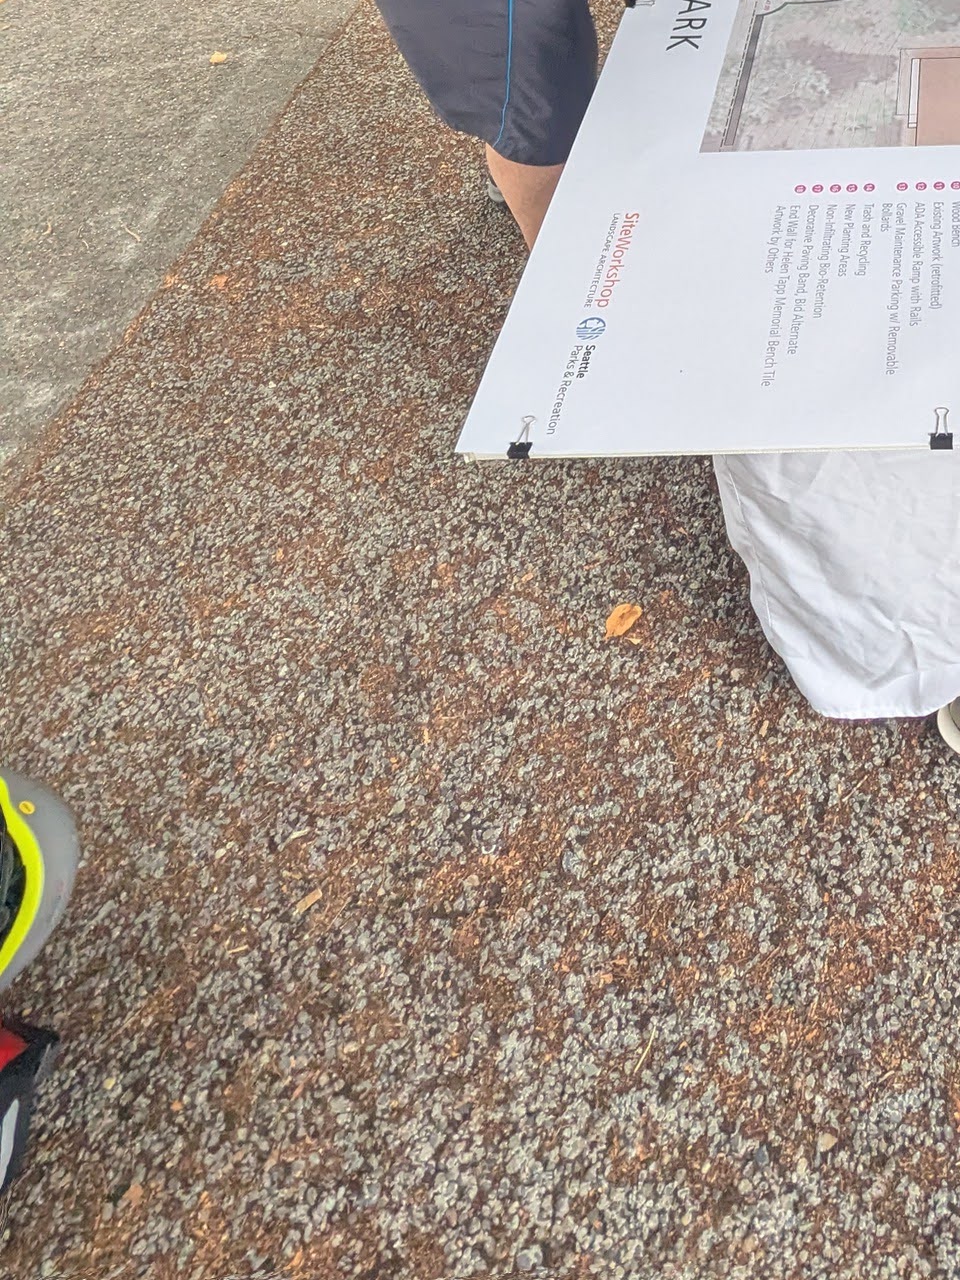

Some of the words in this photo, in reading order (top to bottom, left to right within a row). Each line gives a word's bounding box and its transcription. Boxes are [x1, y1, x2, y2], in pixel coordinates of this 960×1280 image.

[771, 206, 786, 235] Artwork
[789, 205, 800, 219] End
[844, 204, 856, 221] New
[862, 203, 874, 222] Trash
[880, 203, 893, 232] Bollards
[895, 203, 907, 226] Gravel
[914, 202, 925, 219] ADA
[930, 202, 944, 229] Existing
[601, 212, 620, 253] LANDSCAPE
[786, 220, 799, 237] Wall
[803, 205, 819, 243] Decorative
[818, 204, 837, 261] Non-Infiltrating
[861, 224, 873, 238] and
[767, 237, 783, 245] by
[784, 239, 797, 249] for
[838, 223, 854, 253] Planting
[912, 220, 925, 258] Accessible
[931, 231, 943, 261] Artwork
[595, 212, 640, 308] SiteWorkshop
[764, 247, 779, 273] Others
[780, 252, 792, 274] Helen
[797, 245, 813, 270] Paving
[854, 240, 871, 276] Recycling
[892, 227, 906, 277] Maintenance
[838, 255, 850, 277] Areas
[909, 261, 923, 284] Ramp
[583, 254, 607, 308] ARCHITECTURE
[774, 275, 790, 295] Tapp
[794, 273, 810, 296] Band,
[813, 263, 830, 318] Bio-Retention
[929, 263, 943, 310] (retrofitted)
[793, 299, 806, 312] Bid
[887, 279, 903, 310] Parking
[910, 285, 922, 304] with
[769, 297, 786, 338] Memorial
[889, 313, 901, 323] w/
[909, 307, 922, 326] Rails
[787, 314, 804, 355] Alternate
[565, 345, 583, 370] Parks
[576, 345, 596, 379] Seattle
[764, 341, 780, 368] Bench
[885, 326, 900, 375] Removable
[563, 371, 574, 379] &
[761, 371, 775, 386] Tile
[546, 380, 572, 435] Recreation
